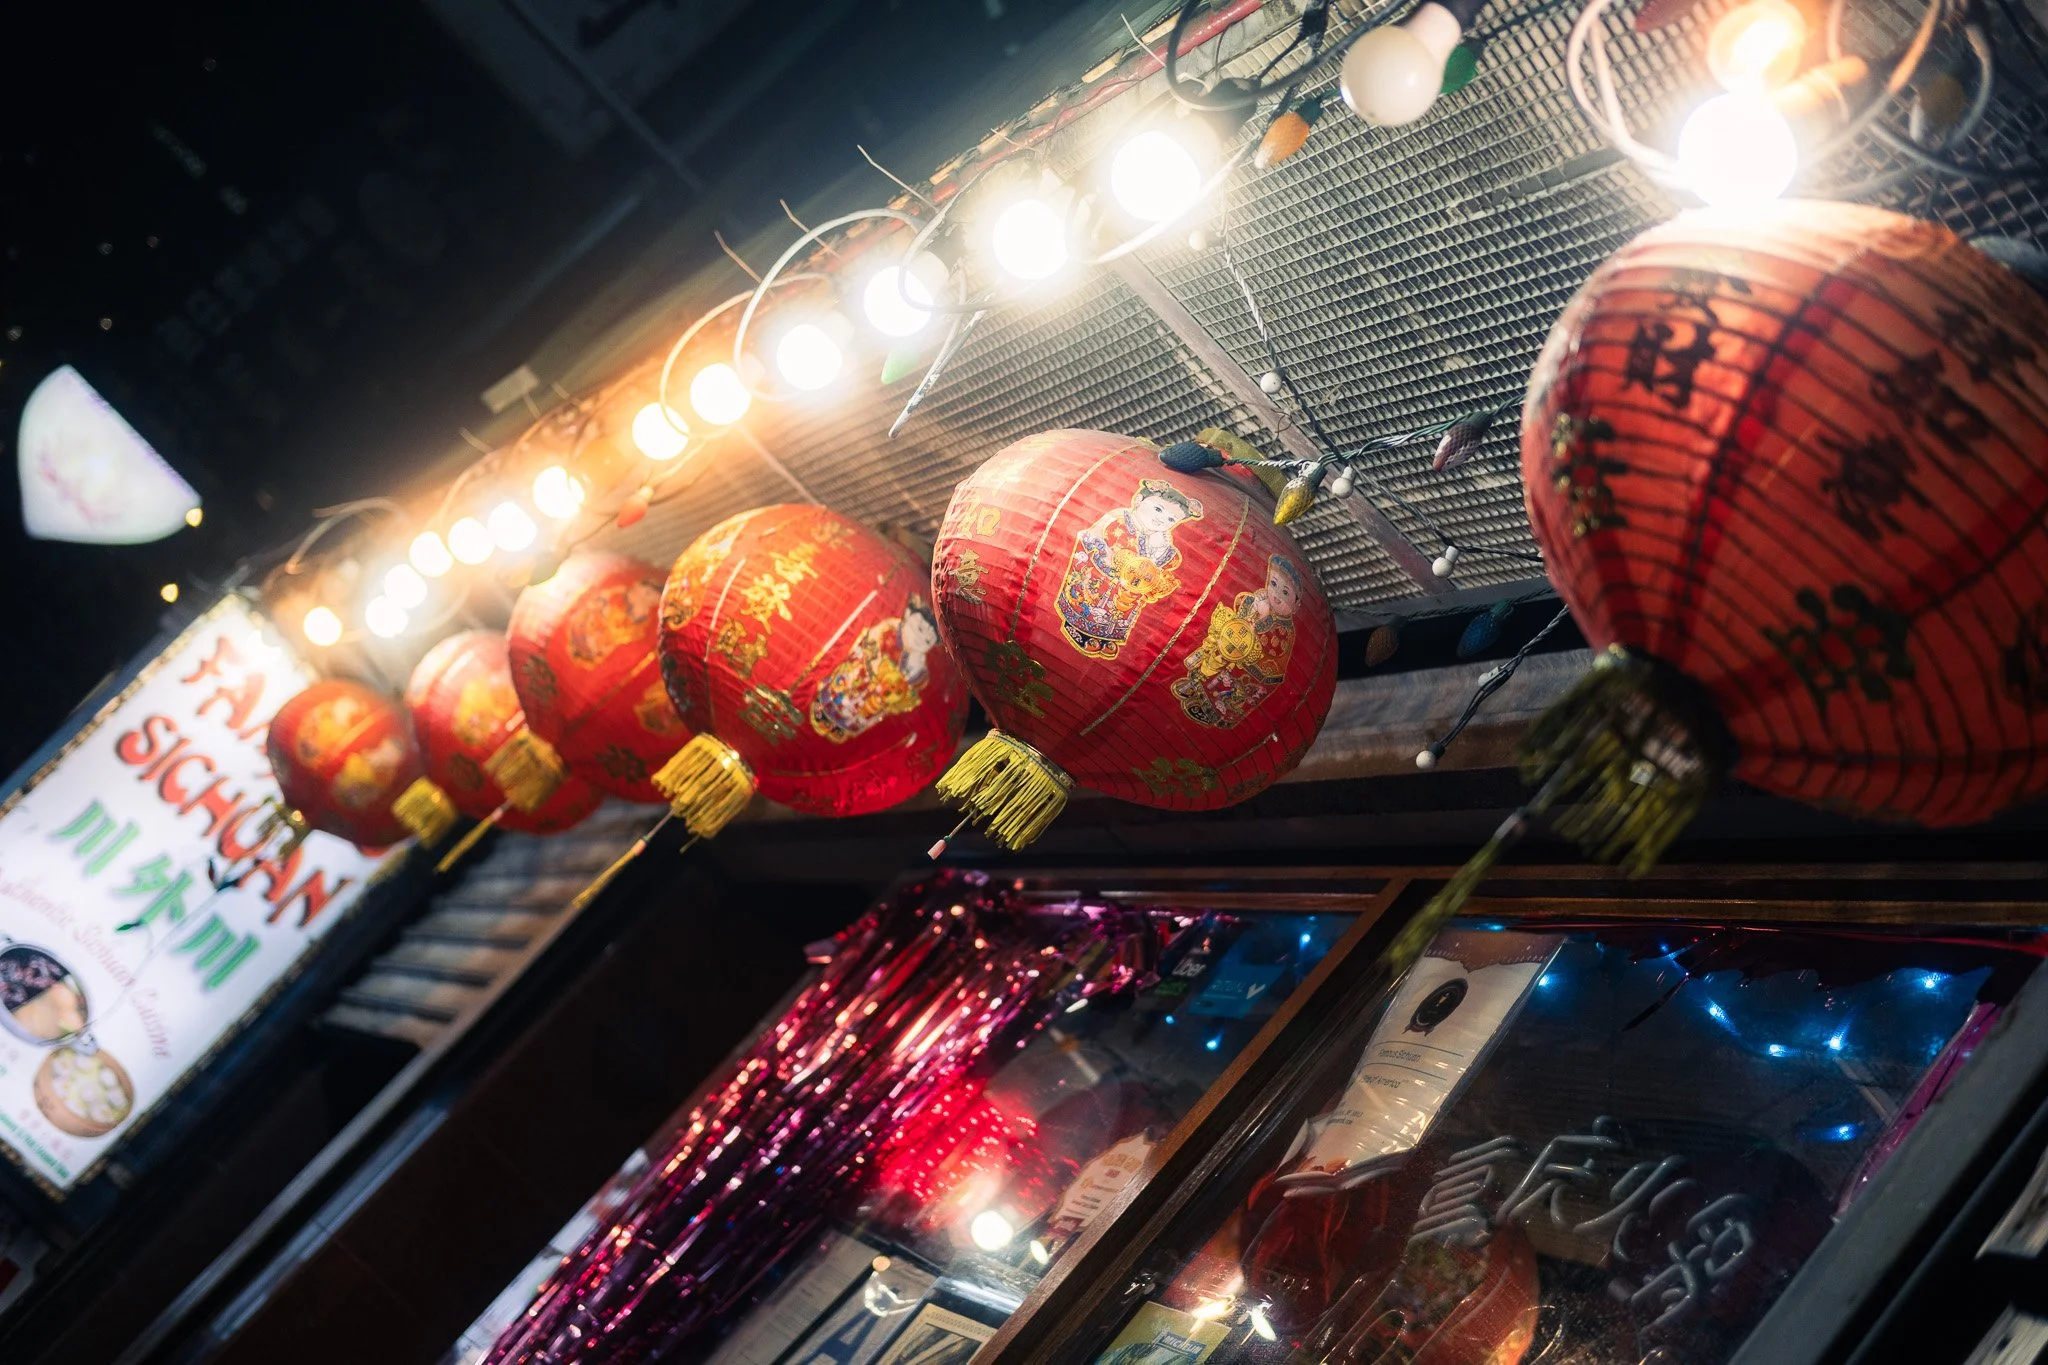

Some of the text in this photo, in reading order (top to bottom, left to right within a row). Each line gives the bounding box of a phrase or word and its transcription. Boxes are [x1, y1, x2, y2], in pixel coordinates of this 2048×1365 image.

[1821, 290, 2040, 541] 祥如意
[51, 798, 261, 993] 川外川
[115, 713, 353, 930] SICHUAN
[1171, 956, 1206, 977] Uber
[1163, 1334, 1204, 1356] MICHELIN
